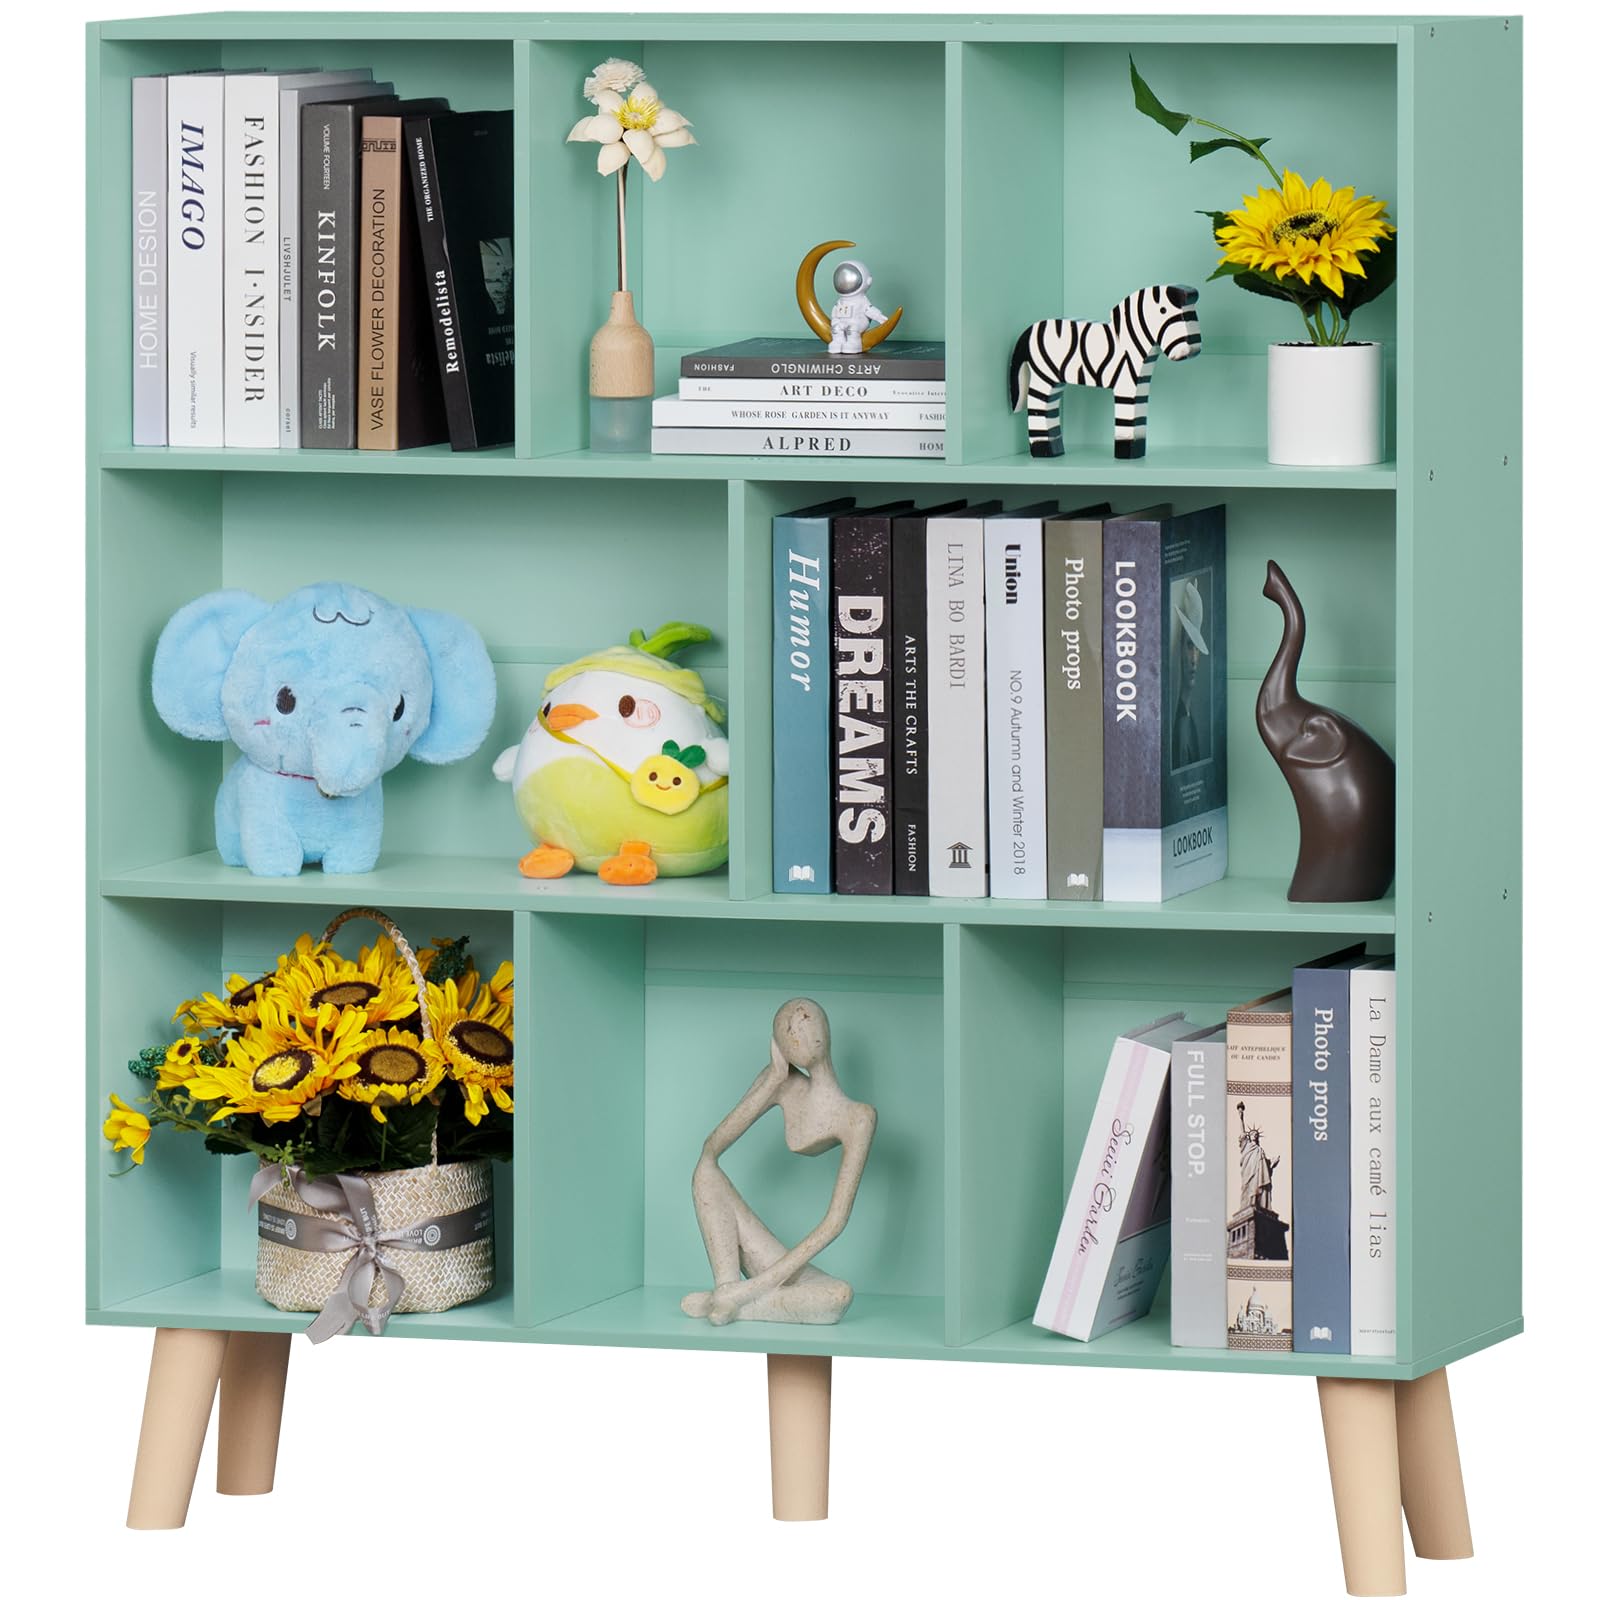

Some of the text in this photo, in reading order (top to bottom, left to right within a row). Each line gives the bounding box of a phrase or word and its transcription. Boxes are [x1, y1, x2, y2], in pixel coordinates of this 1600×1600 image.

[181, 120, 206, 251] IMAGO
[245, 117, 264, 242] FASHION
[415, 137, 434, 223] THE ORGANIZED HOME
[138, 191, 158, 369] HOME DESIGN
[318, 211, 335, 350] KINFOLK
[371, 189, 385, 430] VASE FLOWER DECORATION
[436, 269, 459, 374] Remodelista
[189, 351, 198, 379] Visually
[189, 379, 198, 404] similar
[731, 410, 890, 420] WHOSE ROSE GARDEN IS IT ANYWAY
[771, 364, 881, 374] ARTS CHIWINGLO
[780, 385, 867, 396] ART DECO
[762, 436, 852, 452] ALPRED
[789, 549, 820, 691] Humor
[948, 544, 965, 688] LINA BO BARDI
[1005, 544, 1021, 604] Union
[1061, 558, 1084, 689] Photo props
[905, 635, 917, 774] ARTS THE CRAFTS
[1115, 560, 1137, 722] LOOKBOOK
[837, 595, 887, 844] DREAMS
[1010, 671, 1026, 875] NO.9 Autumn and Winter 2018
[908, 825, 916, 871] FASHION
[1173, 825, 1213, 857] LOOKBOOK
[1188, 1049, 1205, 1177] FULL STOP.
[1309, 1008, 1333, 1141] Photo props
[1369, 998, 1387, 1259] La Dame aux camé lias
[1079, 1183, 1116, 1257] Garden
